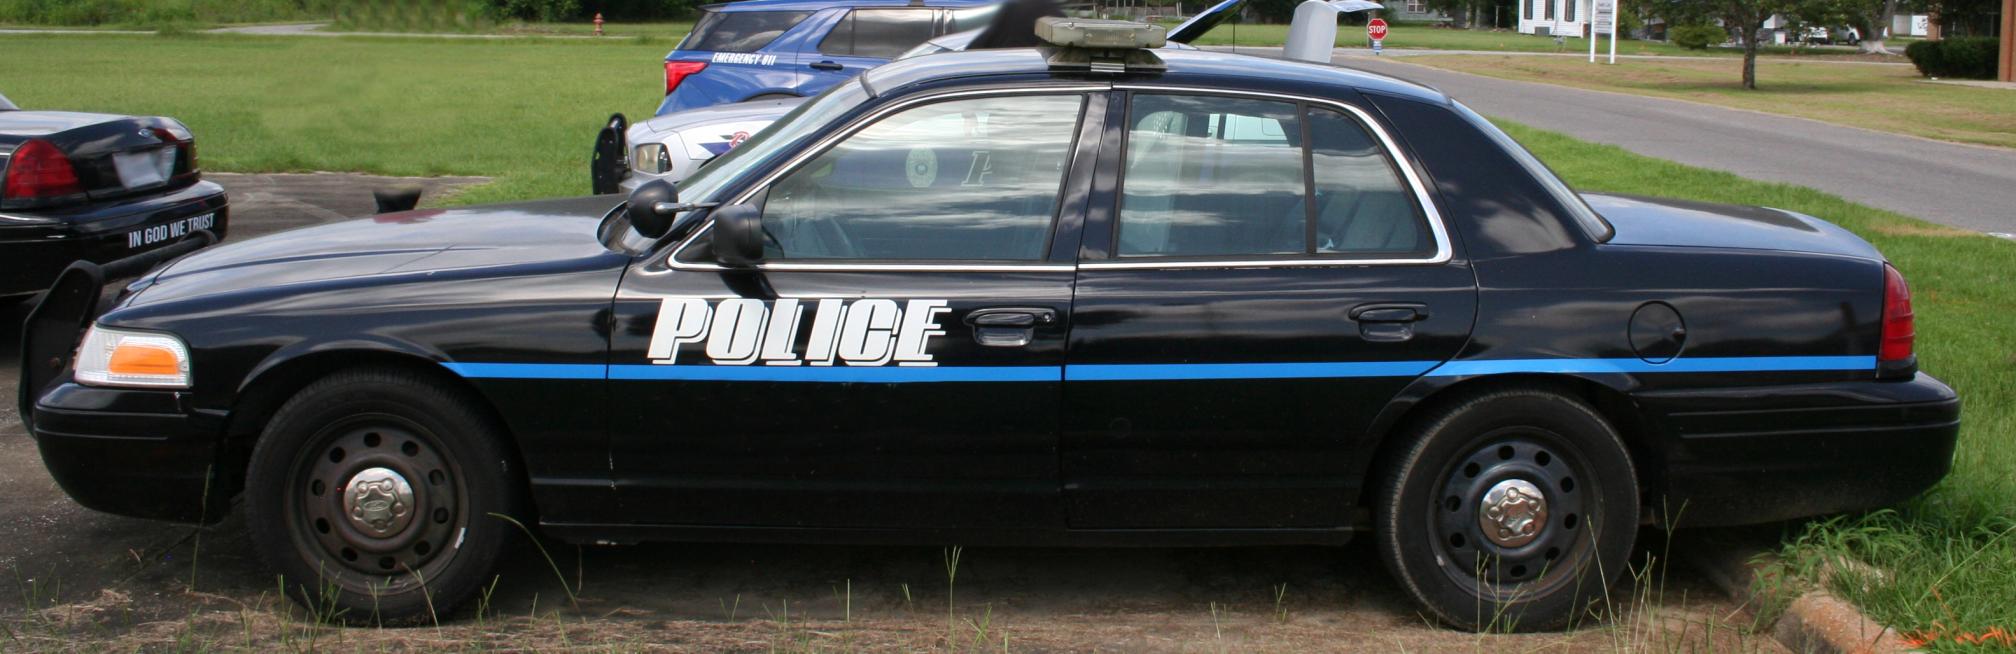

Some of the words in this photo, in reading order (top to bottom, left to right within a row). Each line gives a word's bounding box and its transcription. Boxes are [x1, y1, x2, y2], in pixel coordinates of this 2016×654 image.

[1368, 25, 1386, 34] STOP
[711, 52, 762, 64] EMERGENCY
[128, 230, 142, 248] IN
[144, 224, 168, 244] GOD
[170, 220, 186, 238] WE
[187, 212, 215, 232] TRUST
[647, 297, 953, 367] POLICE
